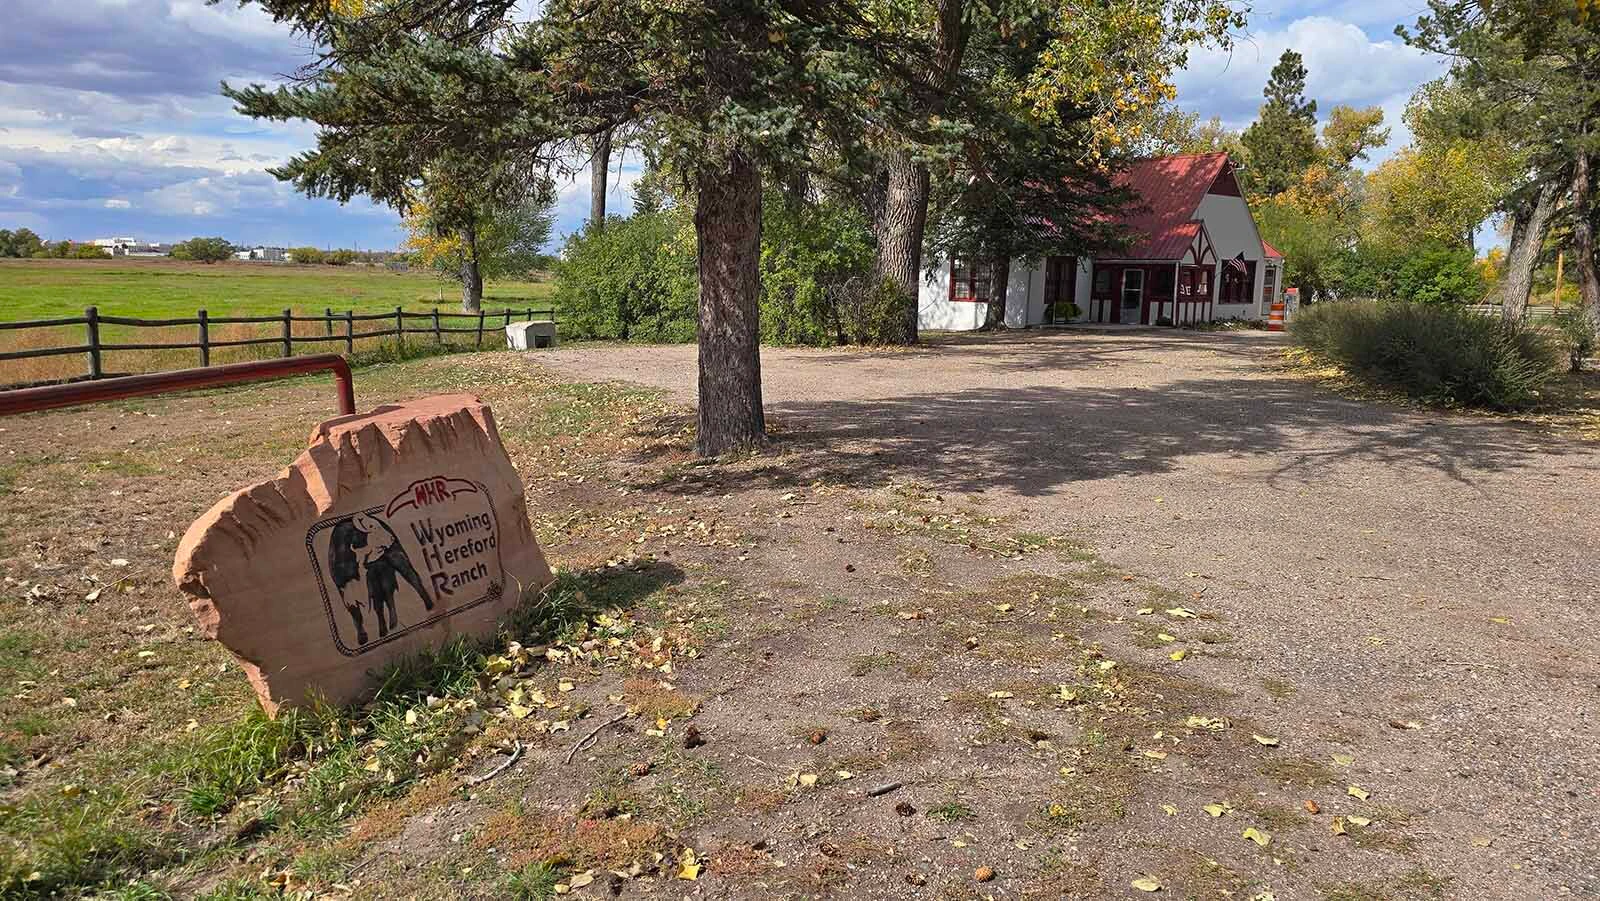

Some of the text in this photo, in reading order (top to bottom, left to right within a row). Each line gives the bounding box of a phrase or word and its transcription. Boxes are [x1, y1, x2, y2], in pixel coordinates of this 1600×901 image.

[410, 511, 492, 547] Wyoming
[421, 531, 497, 572] Hereford
[430, 561, 488, 600] Ranch
